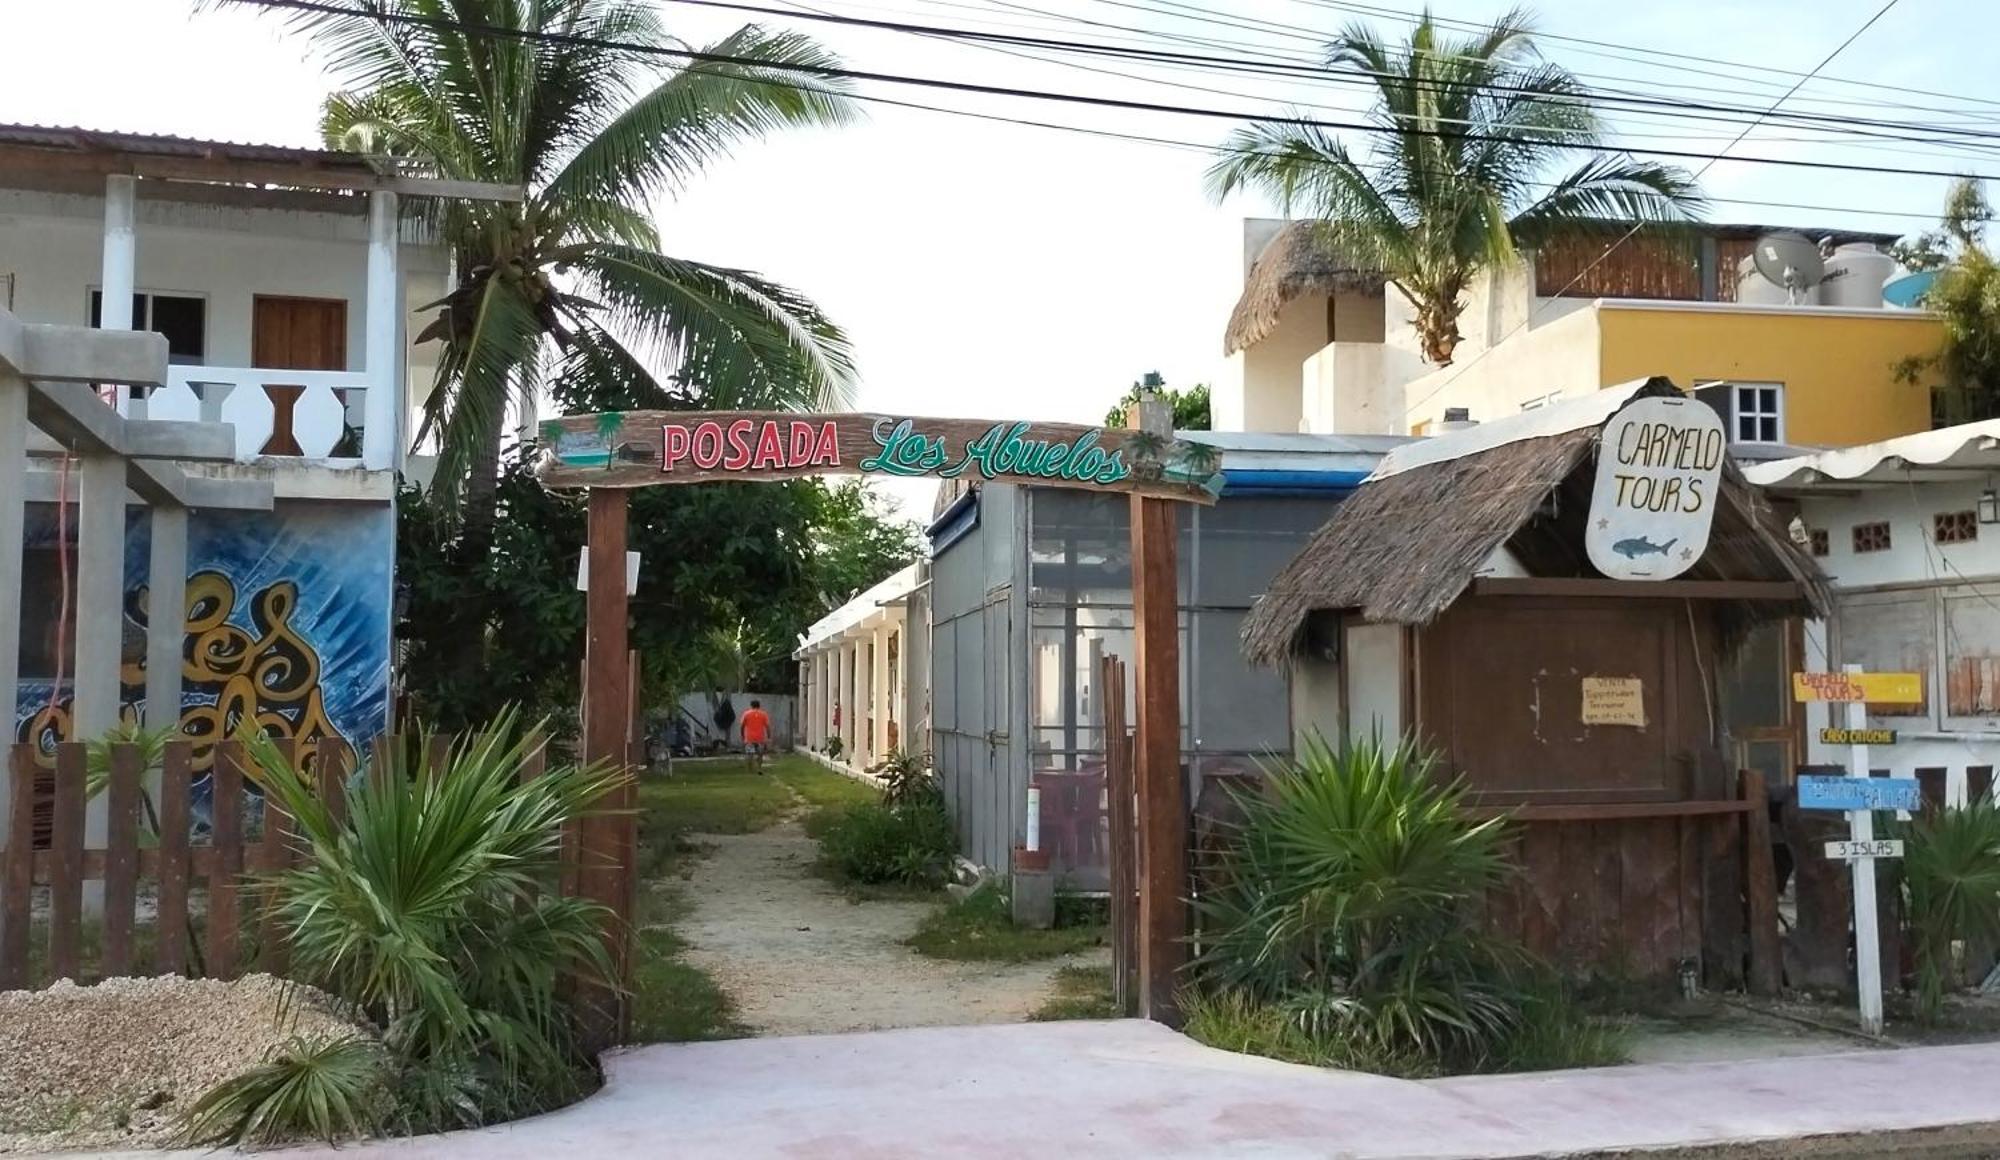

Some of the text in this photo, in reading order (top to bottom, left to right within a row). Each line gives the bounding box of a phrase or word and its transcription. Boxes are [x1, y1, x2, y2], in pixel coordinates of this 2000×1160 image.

[662, 416, 1133, 484] POSADA Los Abuelos
[1617, 421, 1722, 471] CARMELO
[1614, 474, 1703, 513] TOUR'S
[1838, 842, 1893, 856] 3 ISLAS
